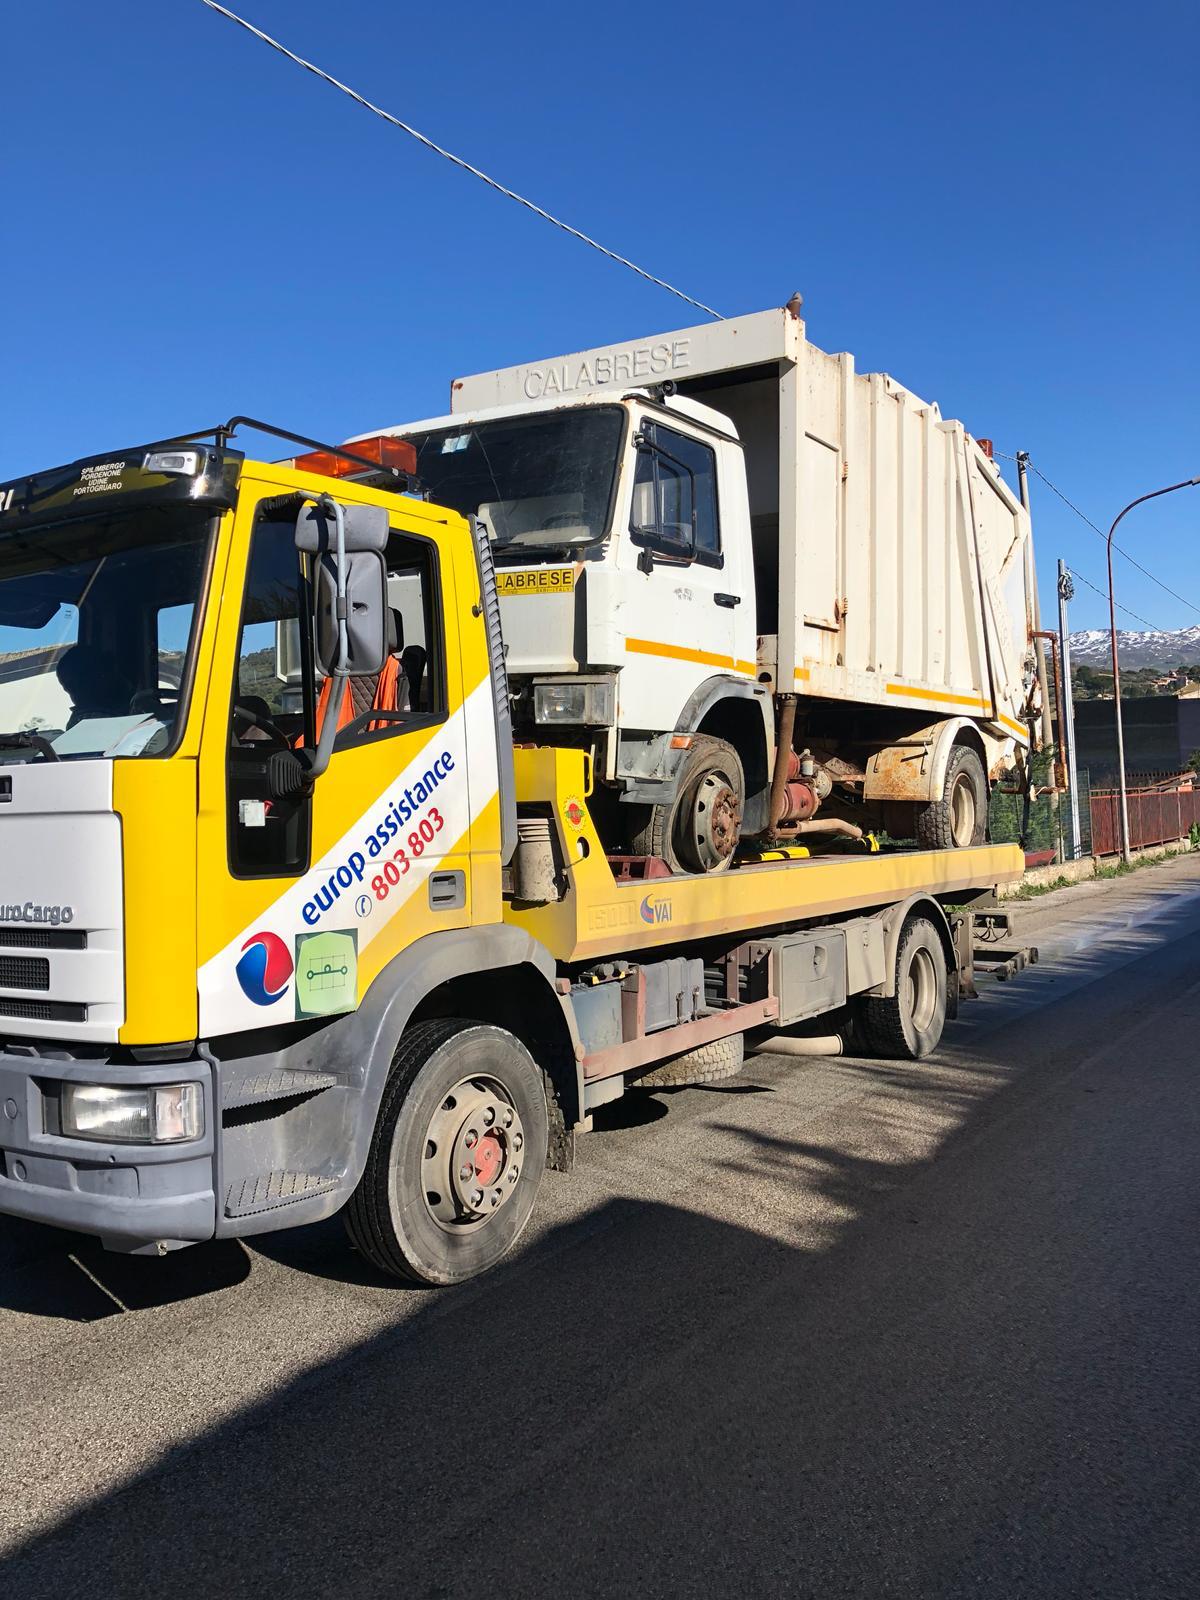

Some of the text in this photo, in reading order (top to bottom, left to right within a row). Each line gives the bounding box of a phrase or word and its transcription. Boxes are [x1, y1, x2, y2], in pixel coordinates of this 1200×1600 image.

[523, 338, 691, 399] CALABRESE
[80, 469, 122, 481] PORDENONE
[81, 461, 125, 475] SPILIMBERGO
[73, 482, 122, 495] PORTOGRUARO
[88, 477, 108, 486] UDINE
[301, 751, 455, 926] europ assistance
[371, 807, 445, 901] 803 803
[654, 903, 672, 923] VAI
